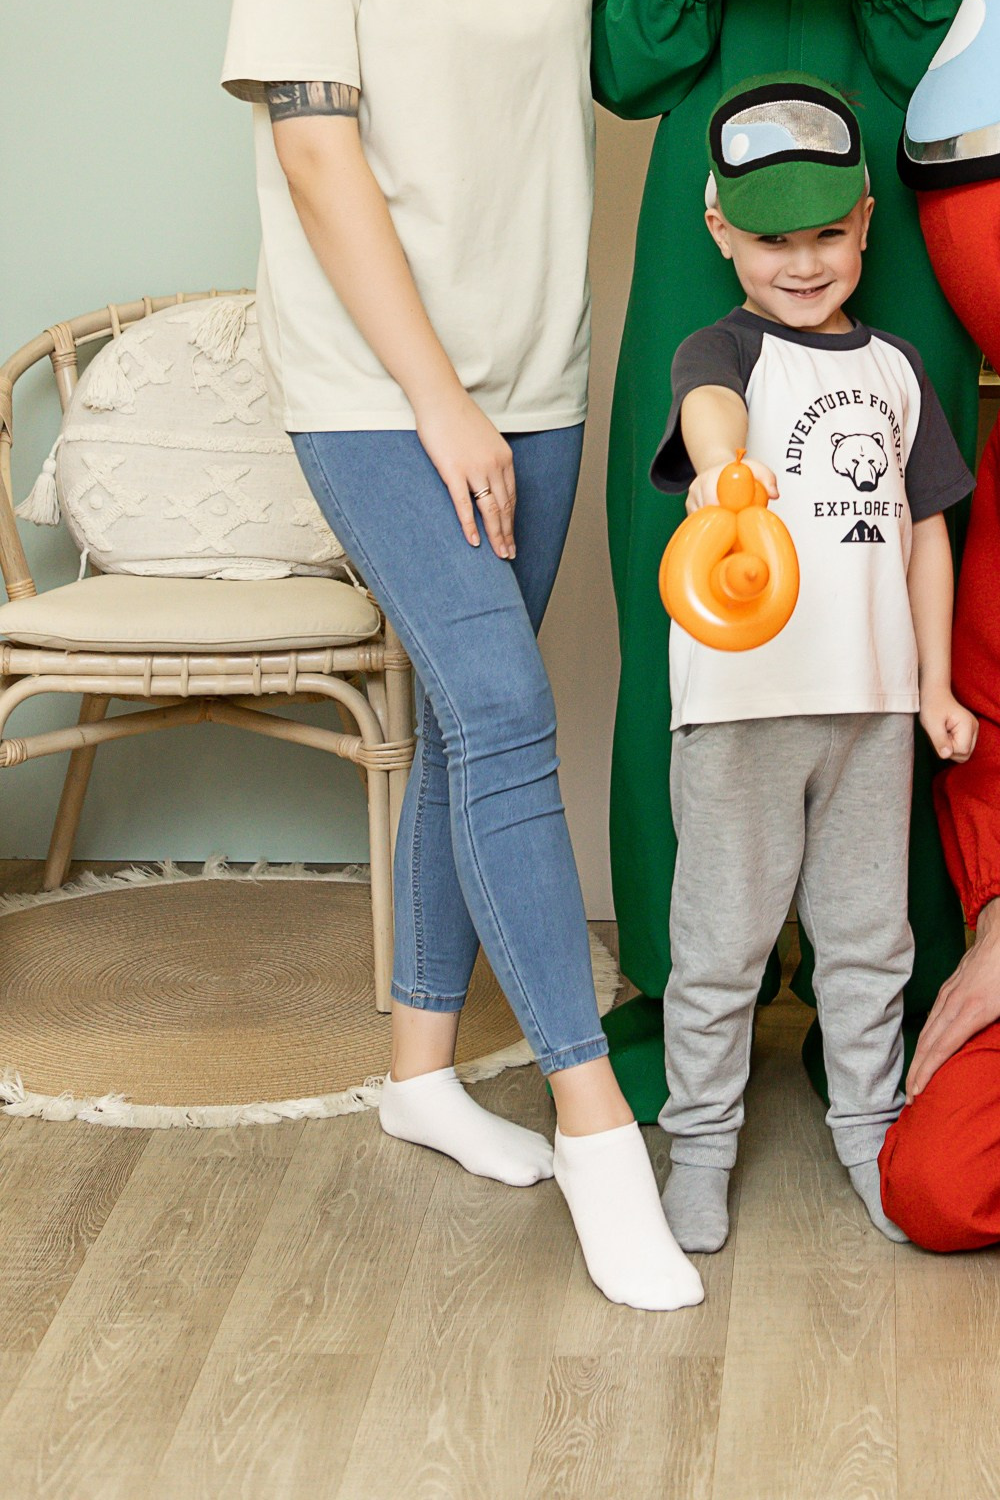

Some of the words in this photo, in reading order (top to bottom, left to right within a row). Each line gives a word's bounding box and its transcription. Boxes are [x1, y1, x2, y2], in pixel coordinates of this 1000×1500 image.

[785, 389, 863, 476] ADVENTURE
[814, 500, 890, 518] EXPLORE
[894, 502, 904, 519] IT
[851, 528, 879, 542] ALL
